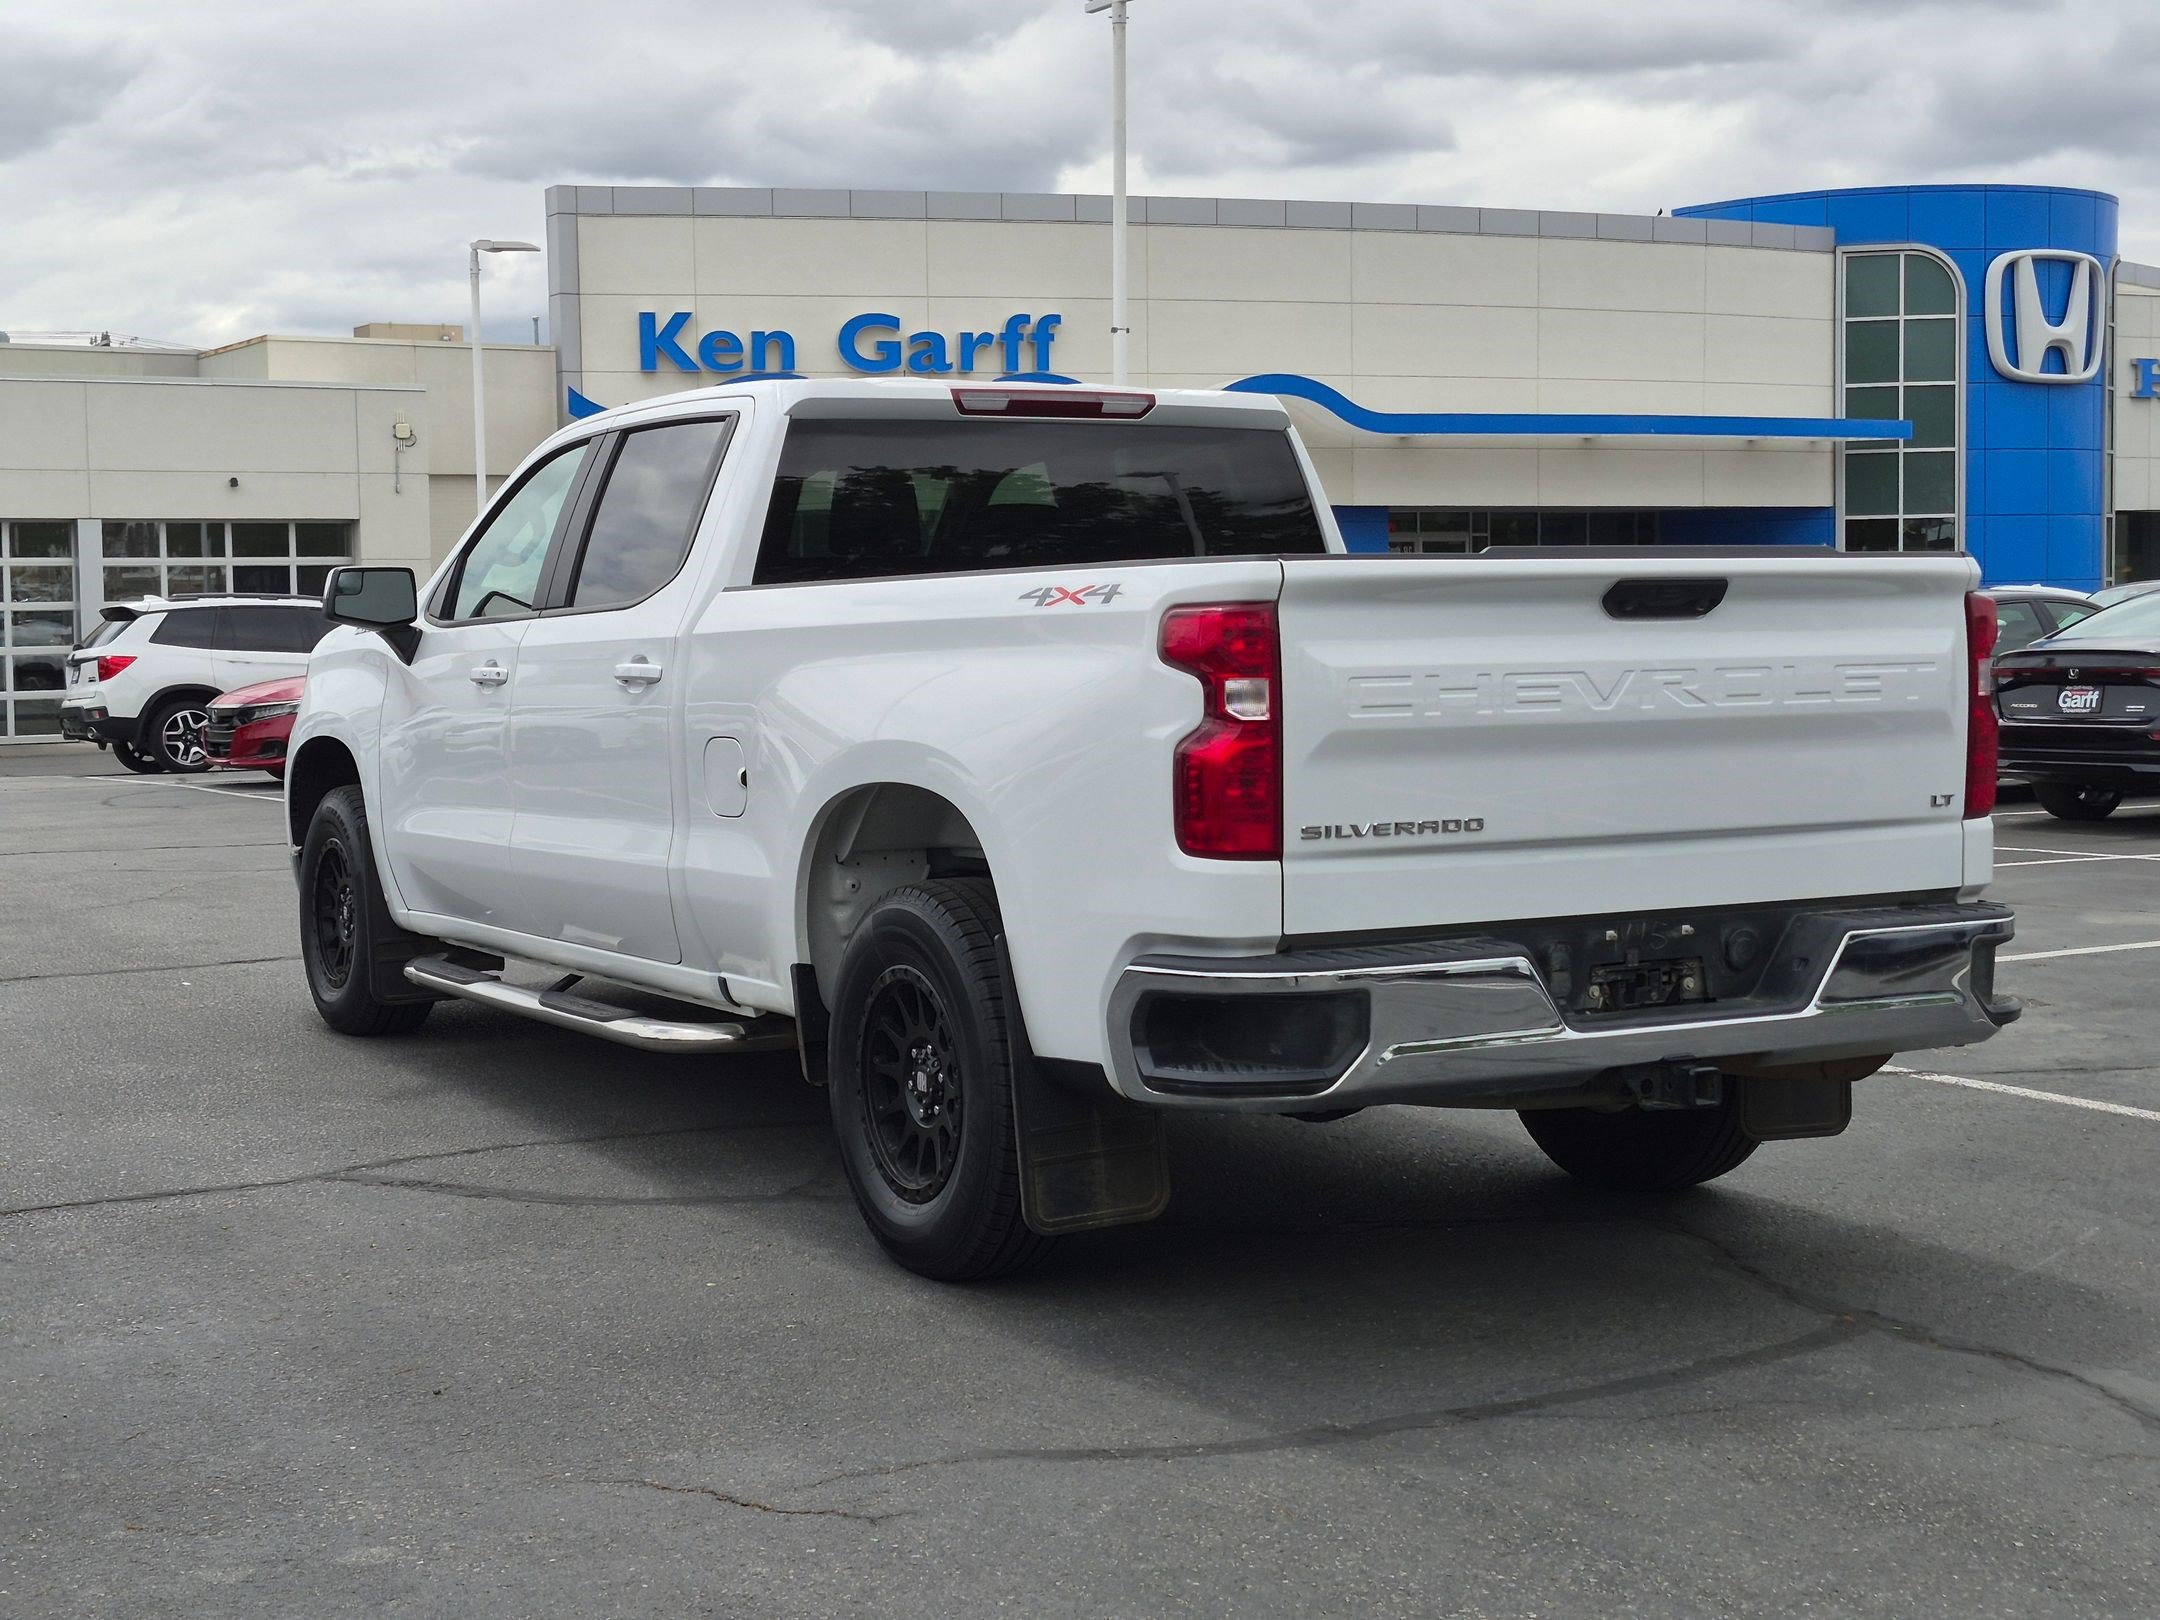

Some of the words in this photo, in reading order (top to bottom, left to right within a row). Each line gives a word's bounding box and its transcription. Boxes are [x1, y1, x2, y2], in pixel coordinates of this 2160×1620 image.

[638, 311, 796, 373] Ken
[837, 312, 1062, 374] Garff
[1348, 661, 1937, 717] CHEVROLET
[2058, 690, 2099, 708] Garff
[1930, 794, 1954, 807] LT
[1301, 817, 1485, 840] SILVERADO
